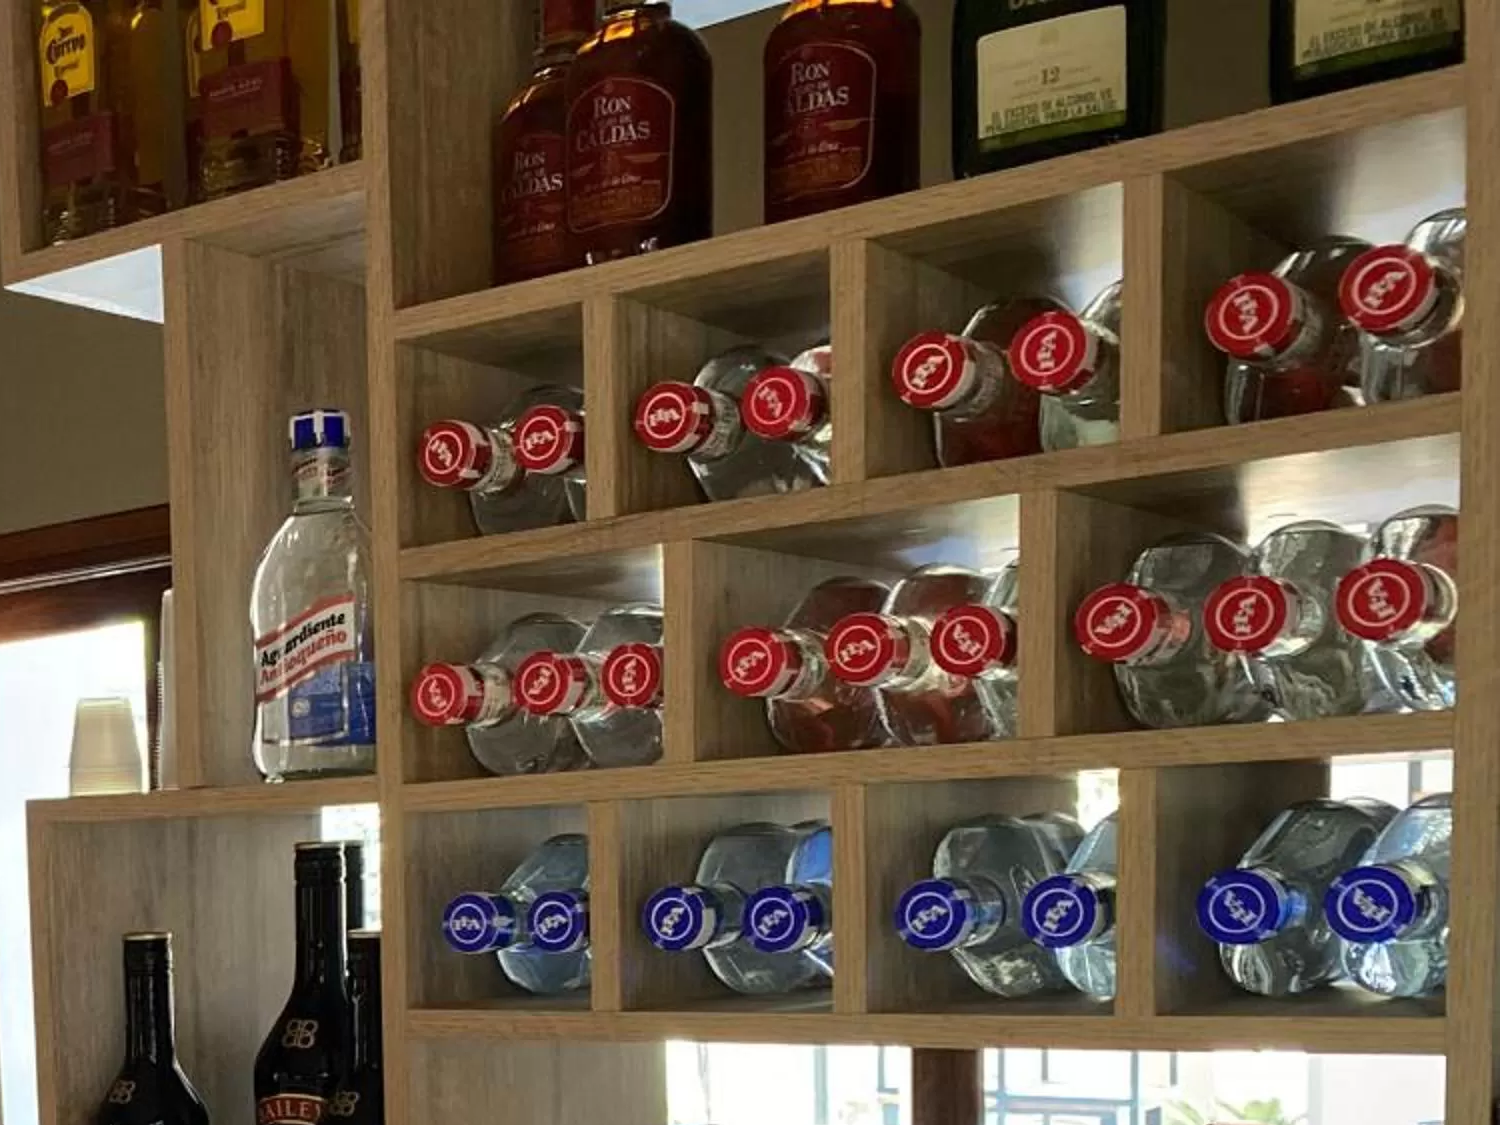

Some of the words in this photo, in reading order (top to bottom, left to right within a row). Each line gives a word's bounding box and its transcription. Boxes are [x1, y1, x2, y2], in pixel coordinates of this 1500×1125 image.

[791, 61, 831, 85] RON
[593, 96, 631, 118] RON
[785, 86, 850, 116] ALDAS
[577, 120, 650, 151] CALDAS
[514, 151, 546, 171] RON
[261, 613, 346, 667] Agardiente
[261, 628, 347, 683] Anioqueño
